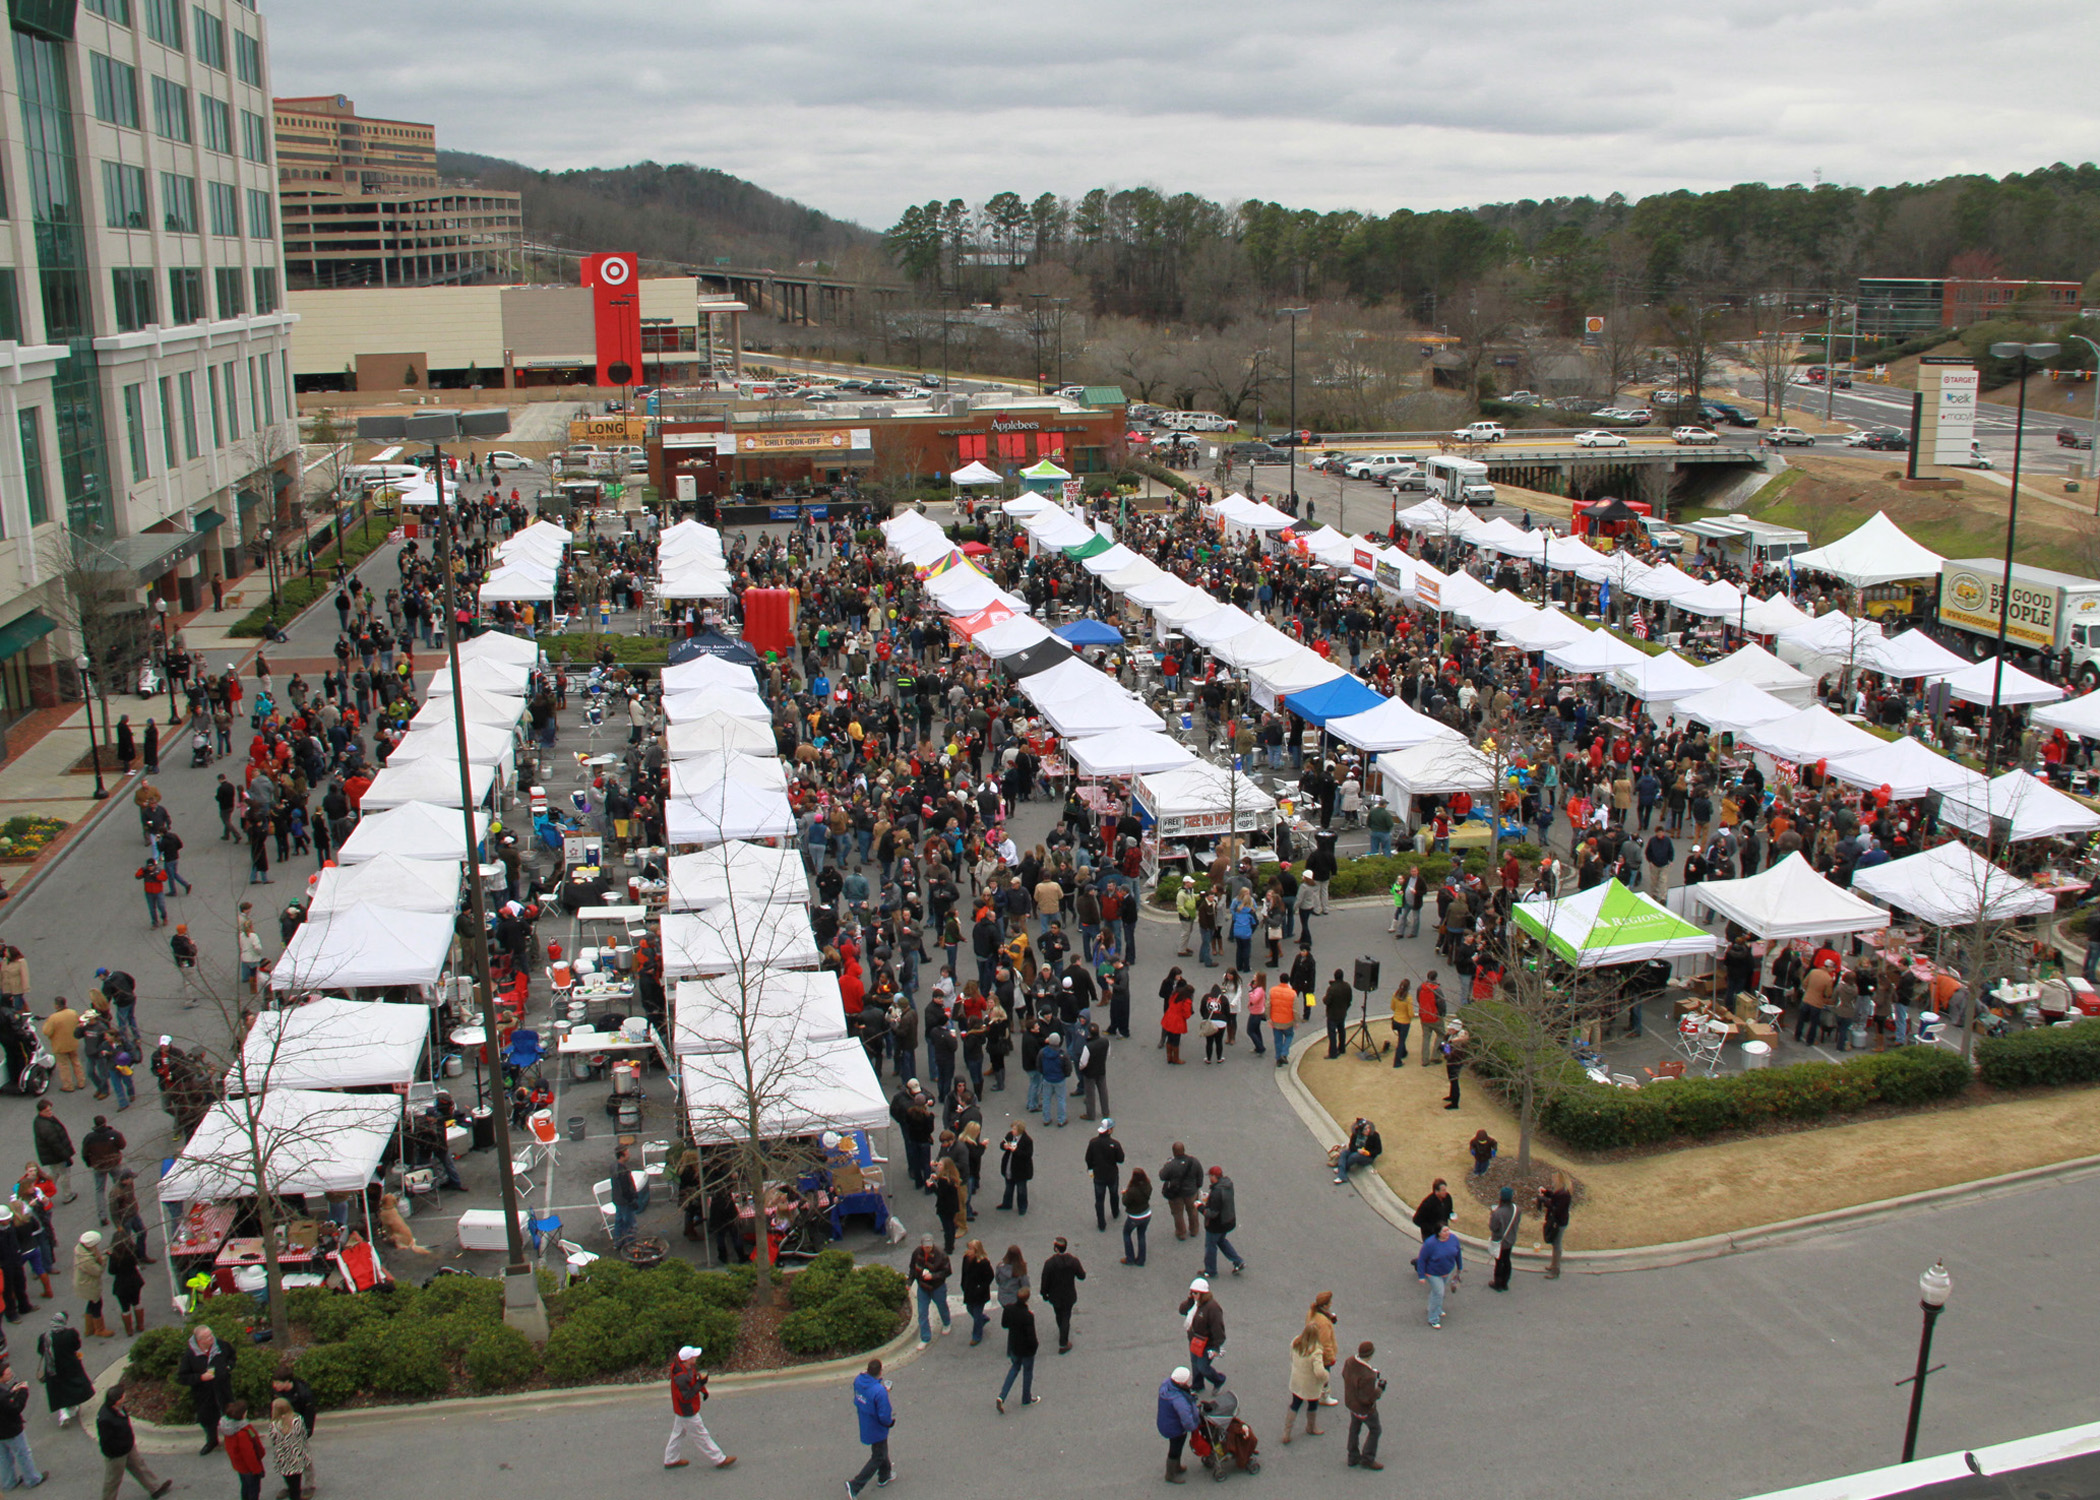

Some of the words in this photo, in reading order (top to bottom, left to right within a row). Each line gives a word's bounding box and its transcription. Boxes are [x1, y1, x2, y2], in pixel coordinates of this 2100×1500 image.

[1950, 376, 1976, 384] TARGET
[1949, 393, 1971, 404] belk
[587, 423, 624, 435] LONG
[764, 439, 783, 447] CHILI
[785, 437, 821, 446] COOK-OFF
[2012, 588, 2052, 609] GOOD
[1164, 818, 1179, 826] FREE
[1184, 815, 1200, 828] FREE
[1611, 912, 1666, 927] REGIONS
